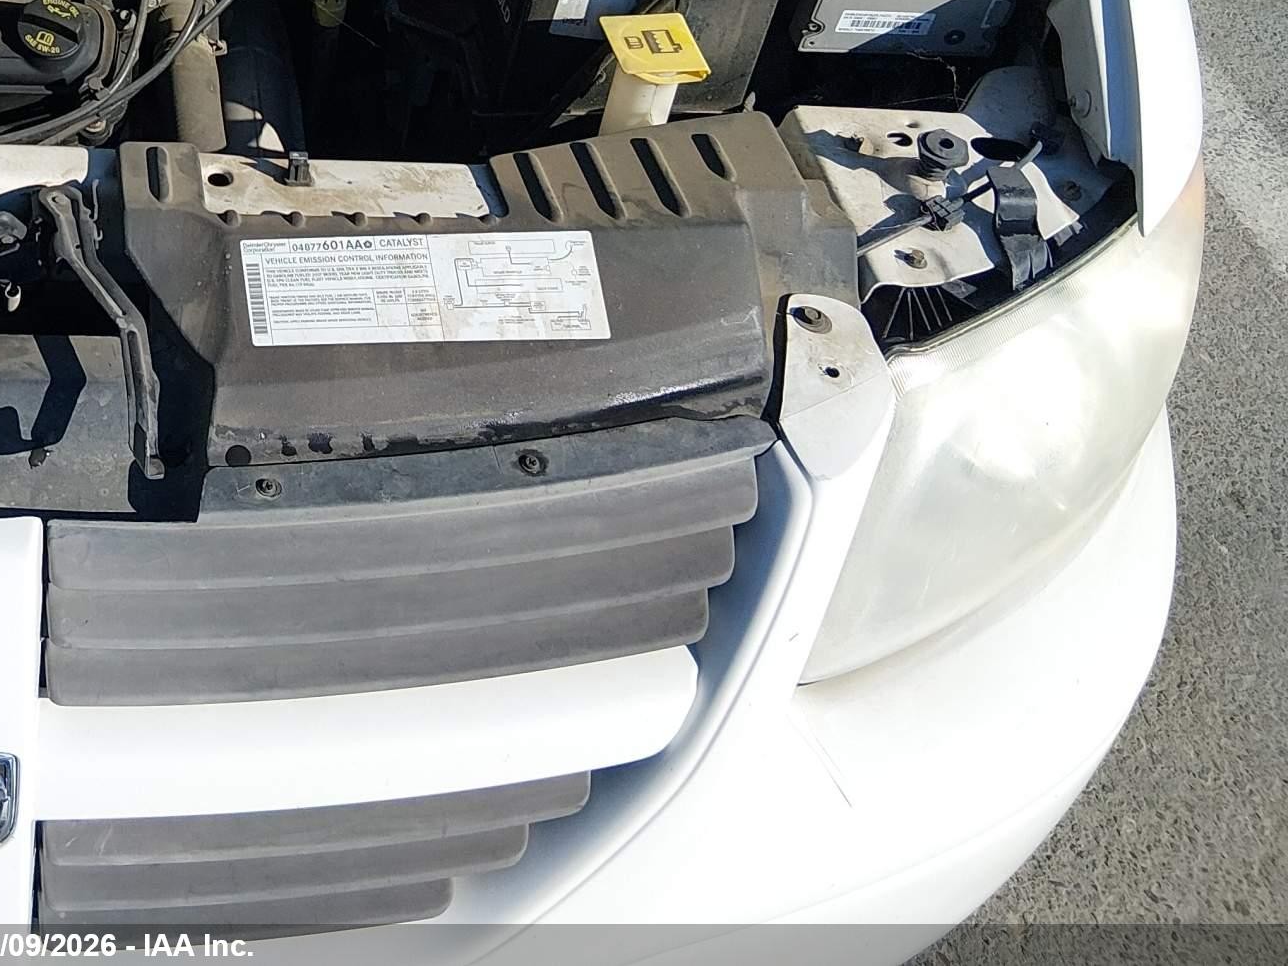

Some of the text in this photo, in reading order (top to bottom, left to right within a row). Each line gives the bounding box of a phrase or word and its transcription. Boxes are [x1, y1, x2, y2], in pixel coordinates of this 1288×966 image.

[69, 6, 80, 18] OIL
[24, 34, 61, 54] SAE 5W-20
[379, 238, 424, 248] CATALYST
[265, 253, 428, 265] VEHICLE EMISSION CONTROL INFORMATION
